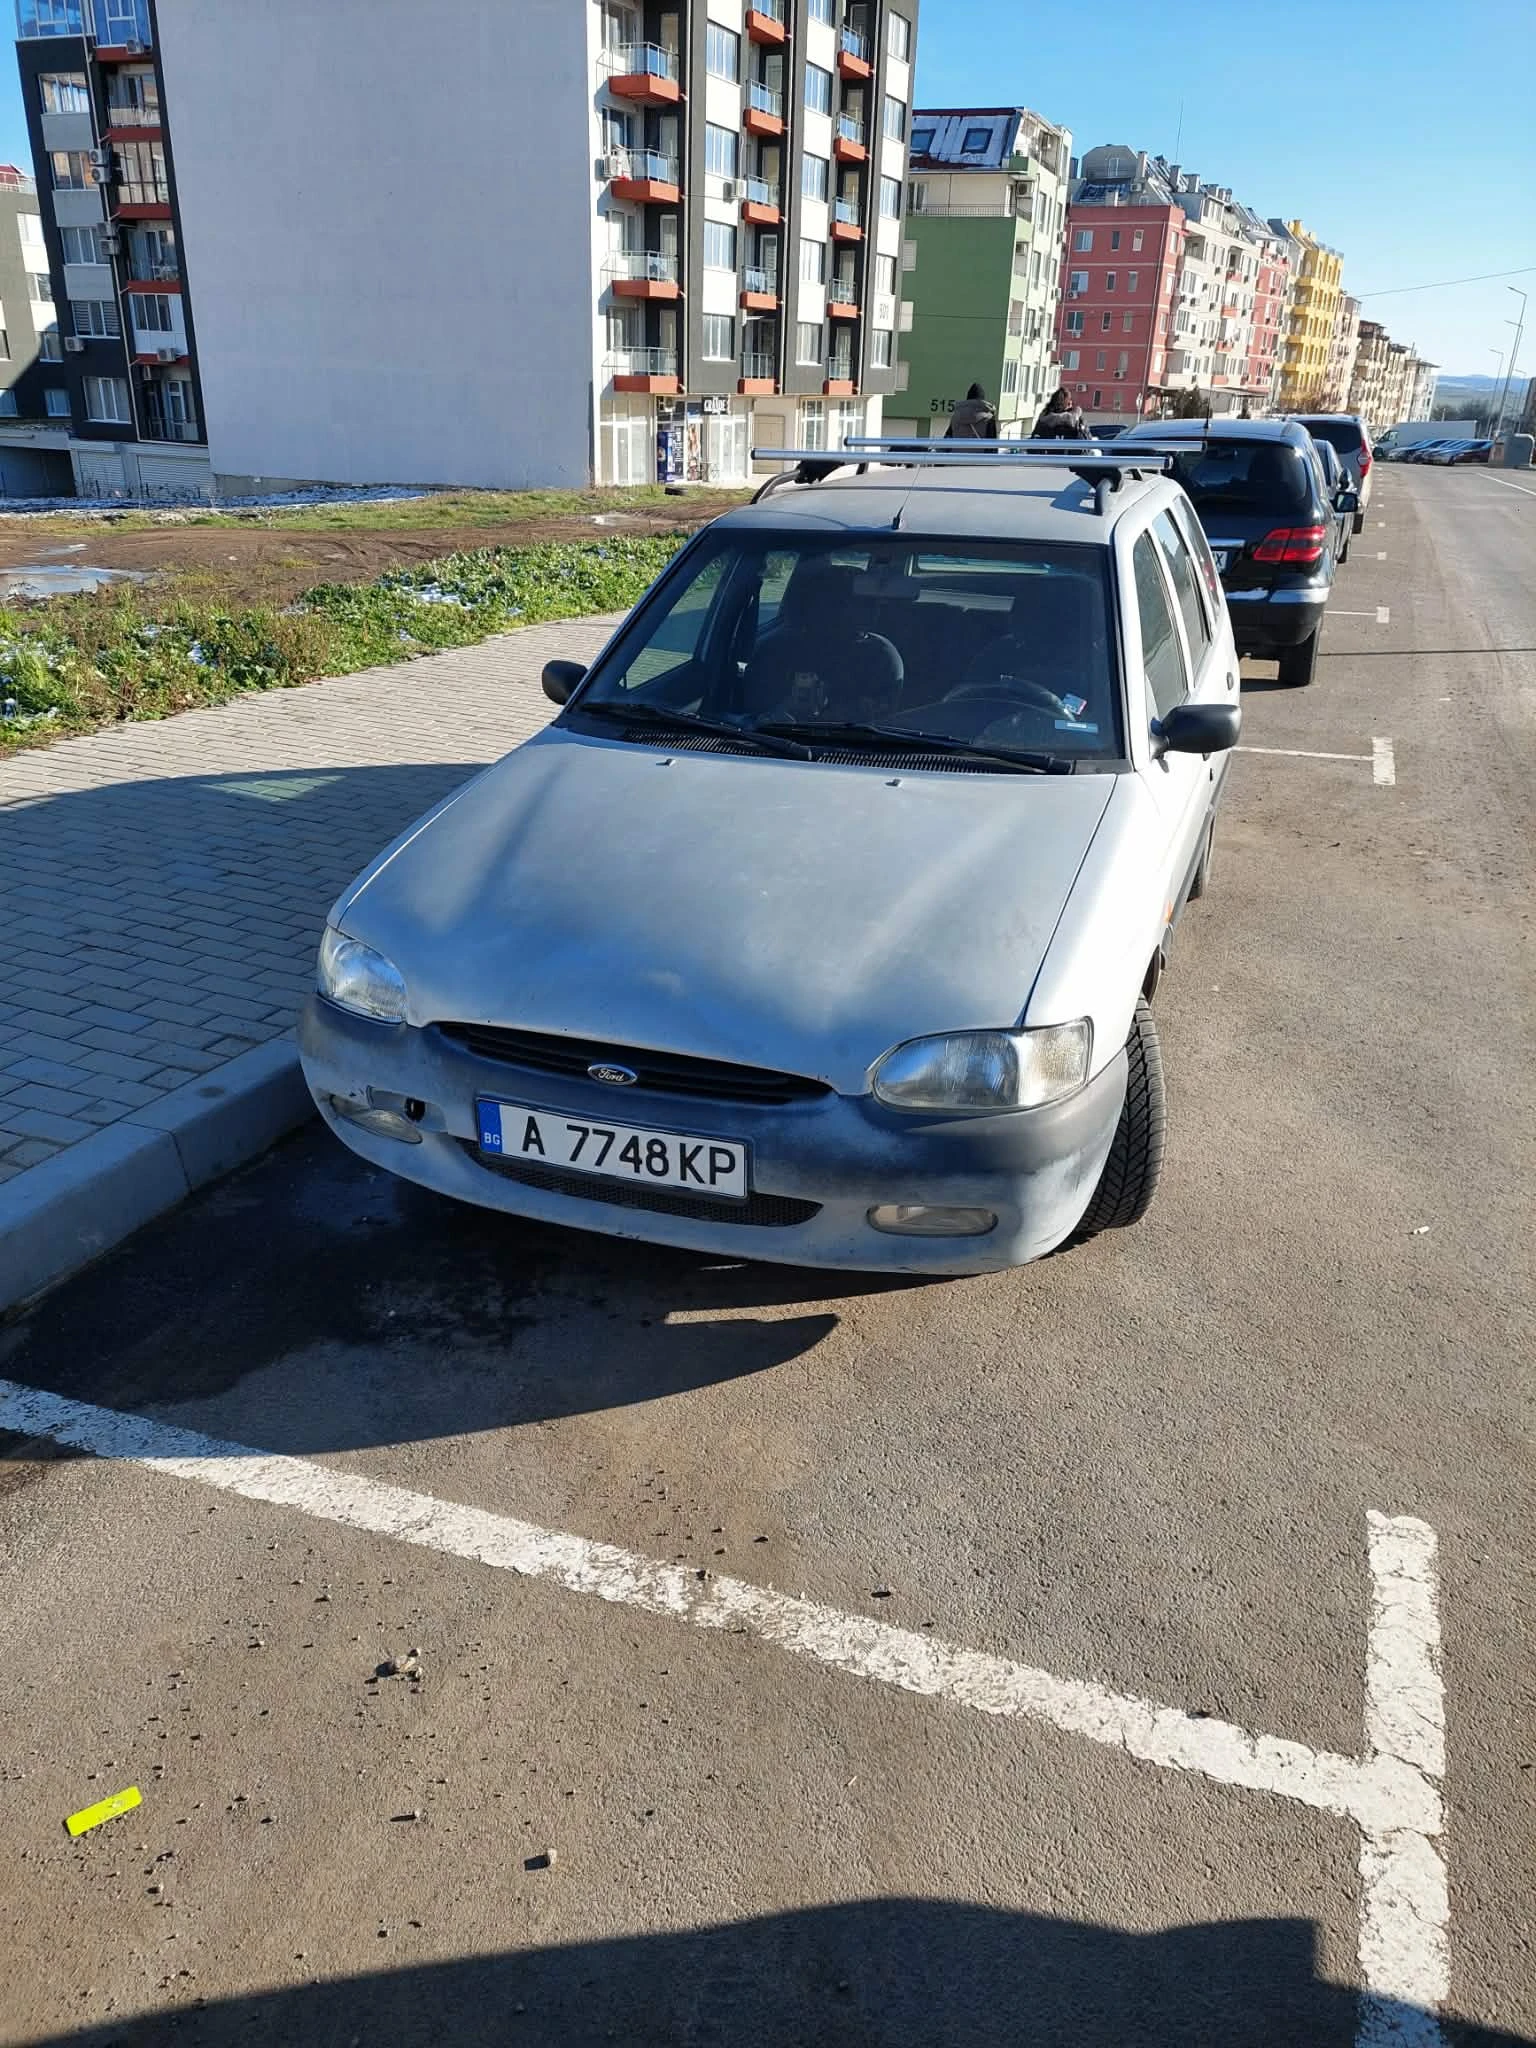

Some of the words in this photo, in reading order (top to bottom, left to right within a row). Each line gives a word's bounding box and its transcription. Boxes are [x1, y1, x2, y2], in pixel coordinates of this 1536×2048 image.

[930, 399, 956, 413] 515
[598, 1067, 625, 1081] Ford
[484, 1132, 500, 1145] BG
[522, 1116, 545, 1156] A
